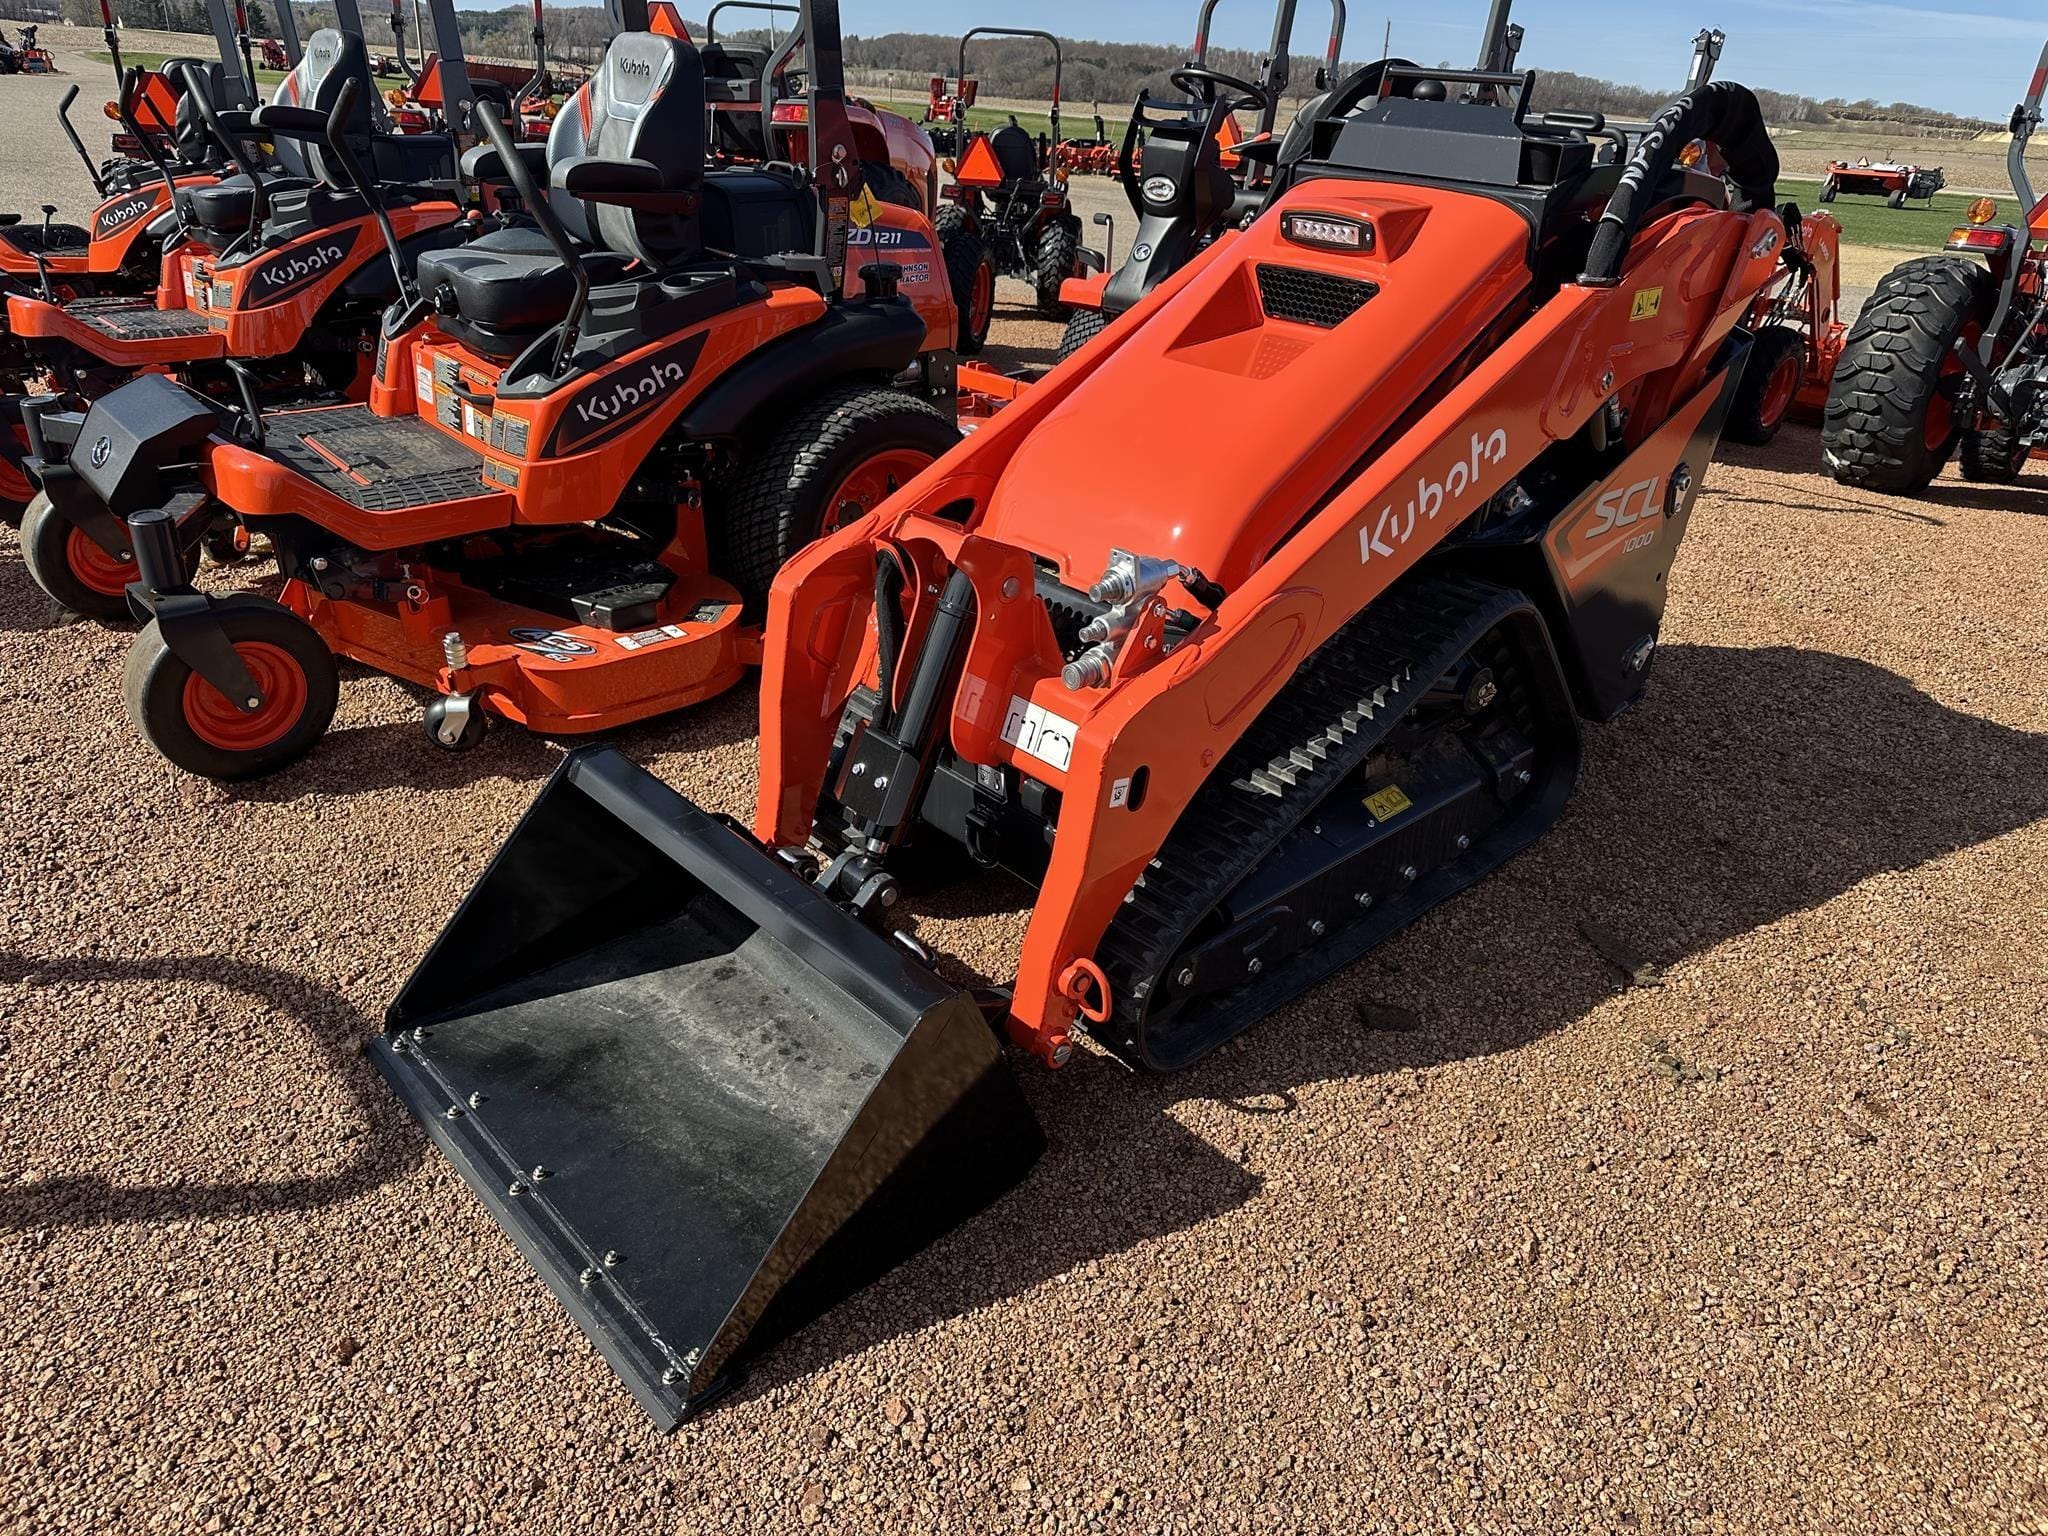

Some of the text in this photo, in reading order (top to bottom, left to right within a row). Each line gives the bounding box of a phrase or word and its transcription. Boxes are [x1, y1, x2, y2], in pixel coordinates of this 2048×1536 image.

[620, 57, 650, 76] Kubota
[100, 201, 148, 226] Kubota
[261, 246, 343, 285] Kubota
[903, 263, 929, 273] HNSON
[900, 273, 929, 284] RACTOR
[576, 362, 684, 422] Kubota
[1359, 428, 1507, 565] Kubota
[1585, 476, 1661, 541] SCL
[1622, 530, 1655, 554] 1000
[543, 653, 576, 663] 60
